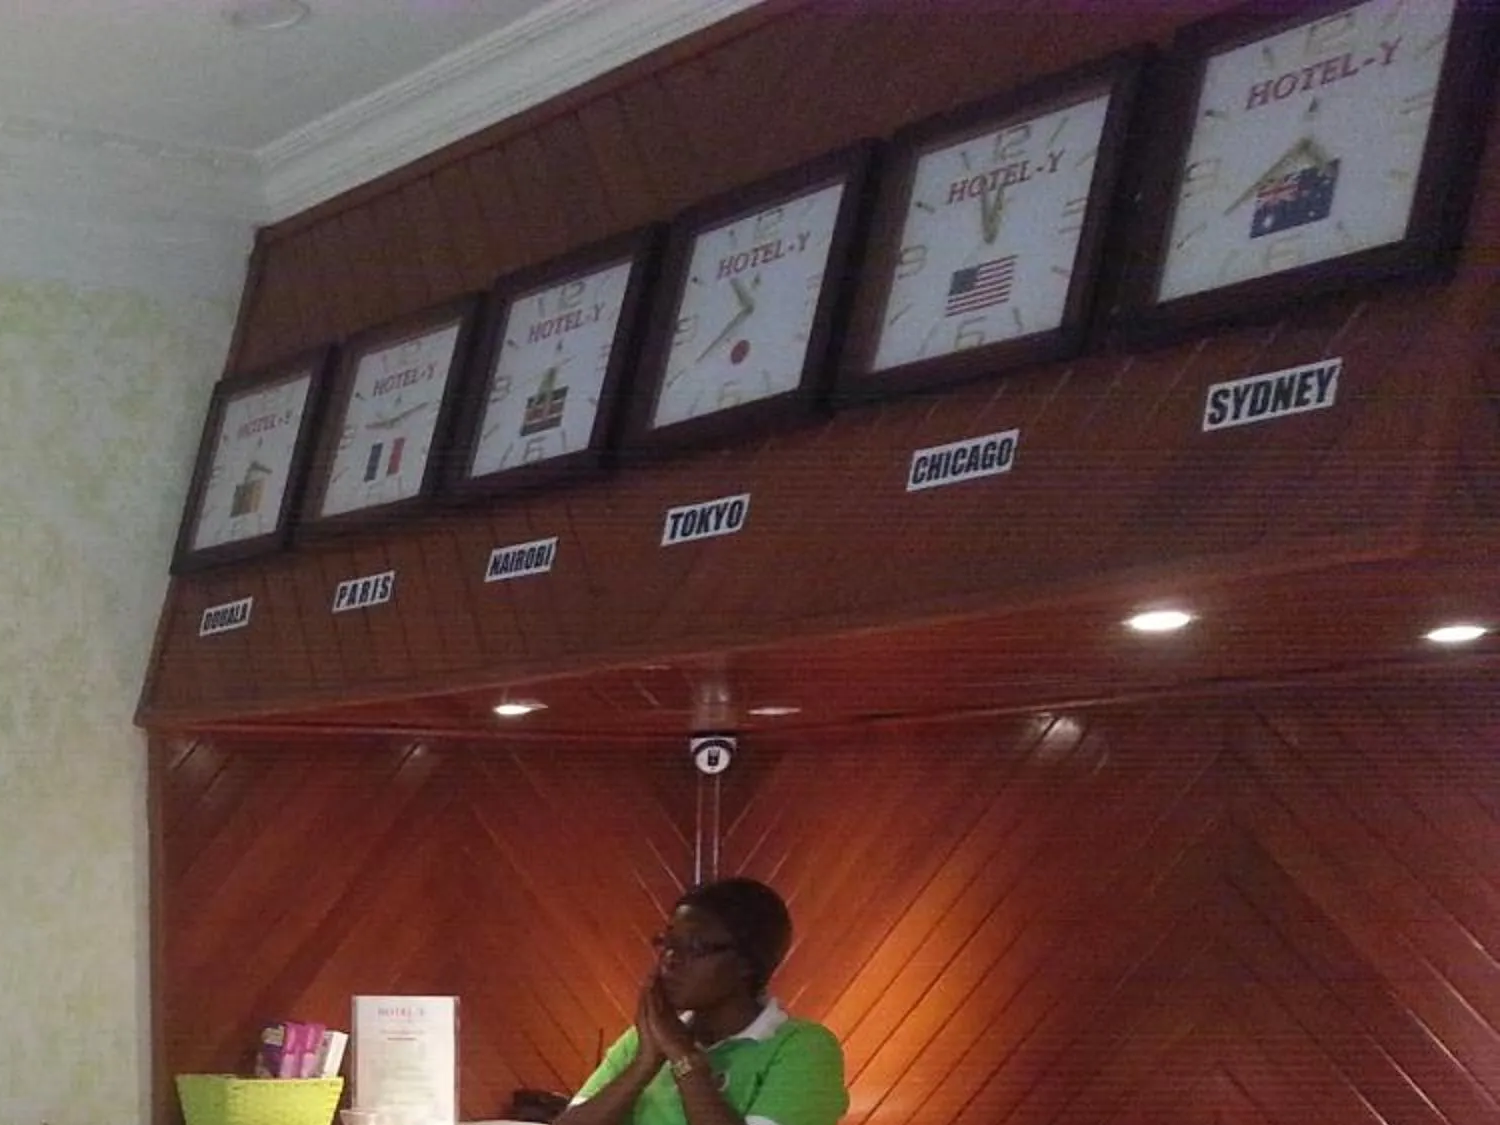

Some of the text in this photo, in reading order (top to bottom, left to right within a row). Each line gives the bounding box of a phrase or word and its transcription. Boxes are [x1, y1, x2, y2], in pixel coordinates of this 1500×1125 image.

[1246, 37, 1403, 110] HOTEL-Y
[947, 149, 1066, 205] HOTEL-Y
[716, 231, 811, 280] HOTEL-Y
[527, 303, 607, 345] HOTEL-Y
[373, 361, 438, 397] HOTEL-Y
[1207, 365, 1338, 425] SYDNEY
[911, 437, 1014, 486] CHICAGO
[668, 499, 746, 540] TOKYO
[488, 542, 554, 577] NAIROBI
[336, 573, 392, 609] PARIS
[203, 602, 249, 631] DOUALA
